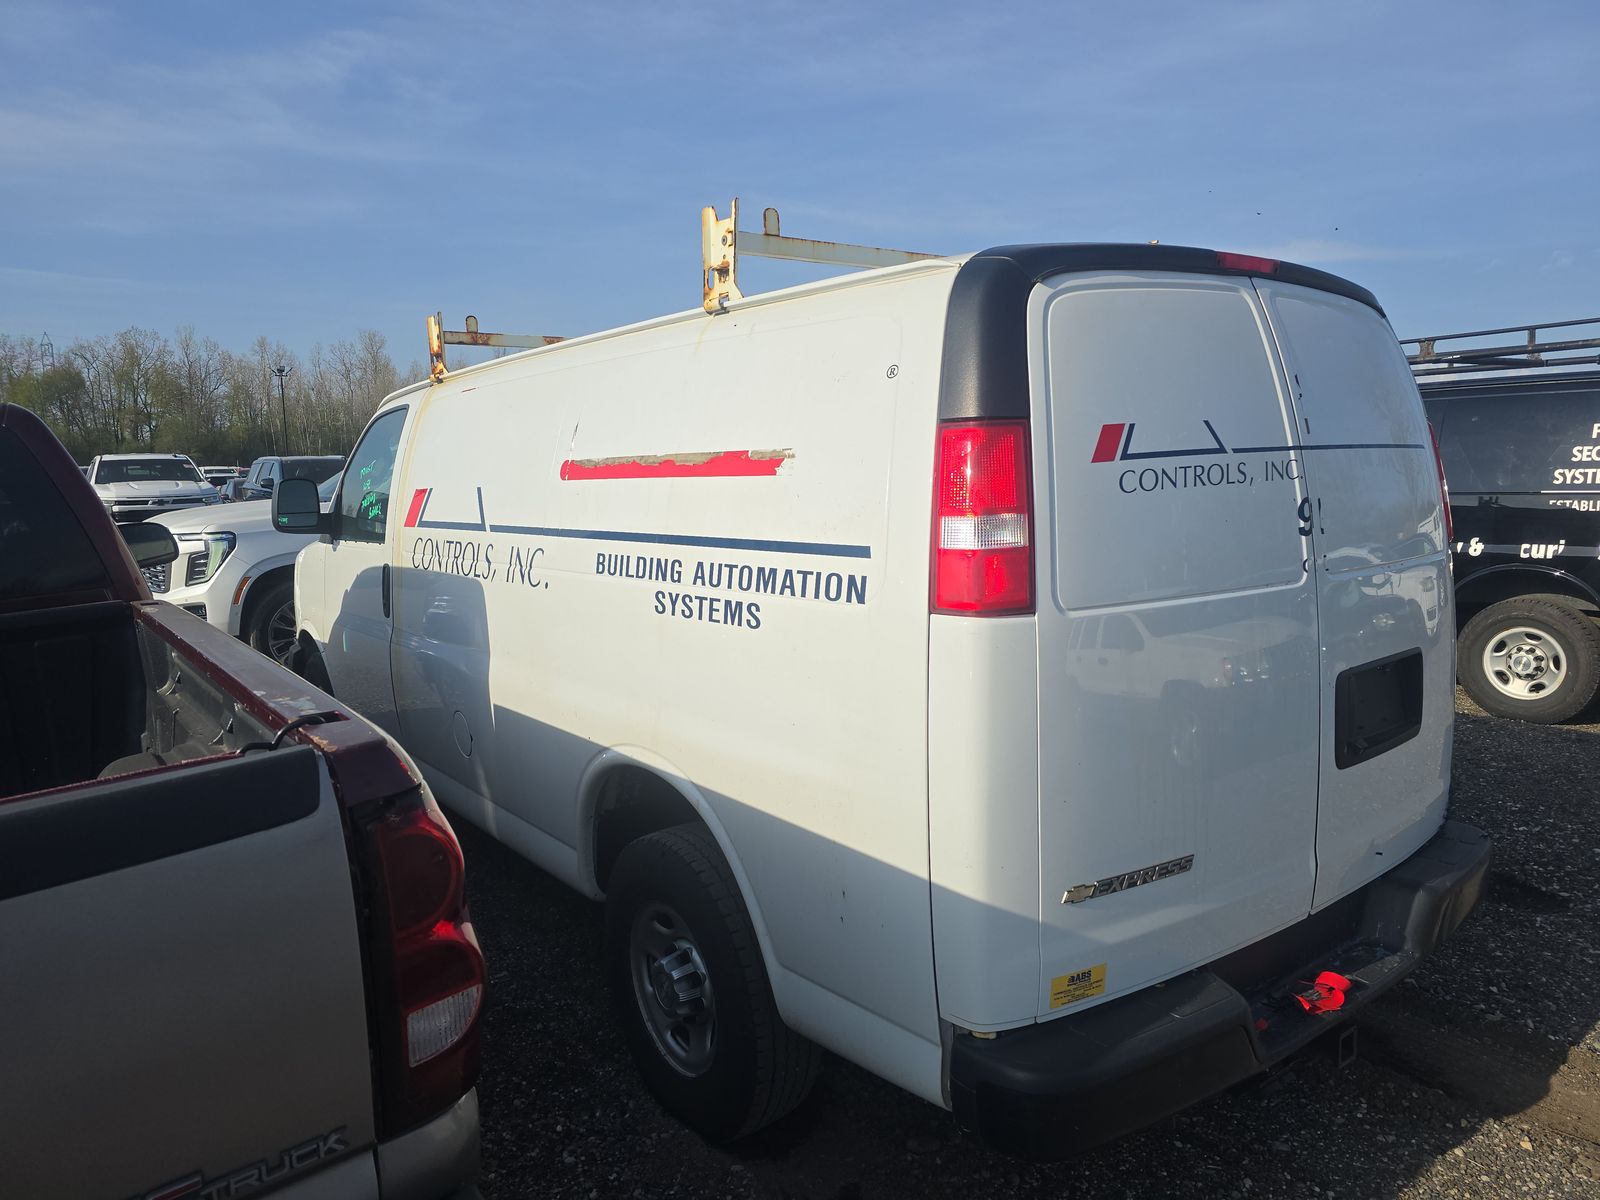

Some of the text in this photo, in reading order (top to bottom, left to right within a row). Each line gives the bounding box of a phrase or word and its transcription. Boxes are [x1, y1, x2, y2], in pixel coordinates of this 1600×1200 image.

[1119, 459, 1304, 494] CONTROLS, INC.
[412, 536, 549, 589] CONTROLS, INC.
[1469, 537, 1485, 557] &
[595, 552, 867, 605] BUILDING AUTOMATION
[654, 591, 761, 630] SYSTEMS
[1095, 855, 1194, 898] EXPRESS
[199, 1124, 349, 1200] TRUCK
